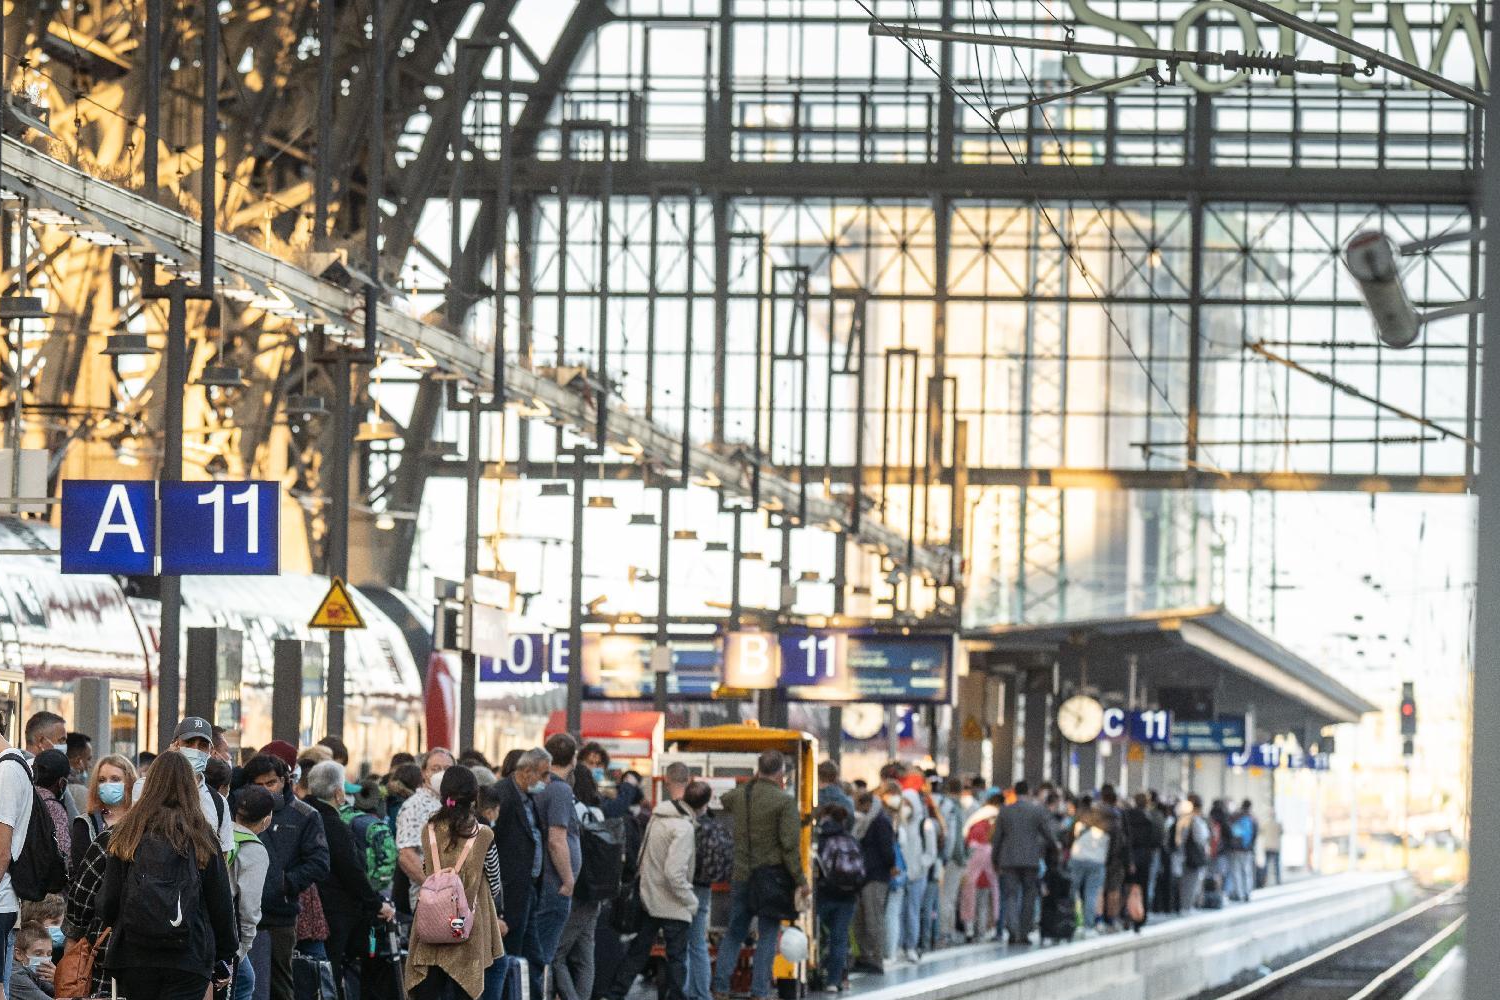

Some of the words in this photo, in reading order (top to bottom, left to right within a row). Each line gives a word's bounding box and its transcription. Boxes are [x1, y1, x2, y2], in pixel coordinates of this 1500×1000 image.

[88, 484, 145, 553] A
[197, 484, 259, 554] 11
[552, 633, 570, 674] E
[738, 635, 770, 676] B
[798, 634, 836, 677] 11
[1102, 707, 1124, 737] C
[1139, 709, 1168, 740] 11
[1259, 743, 1280, 766] 11
